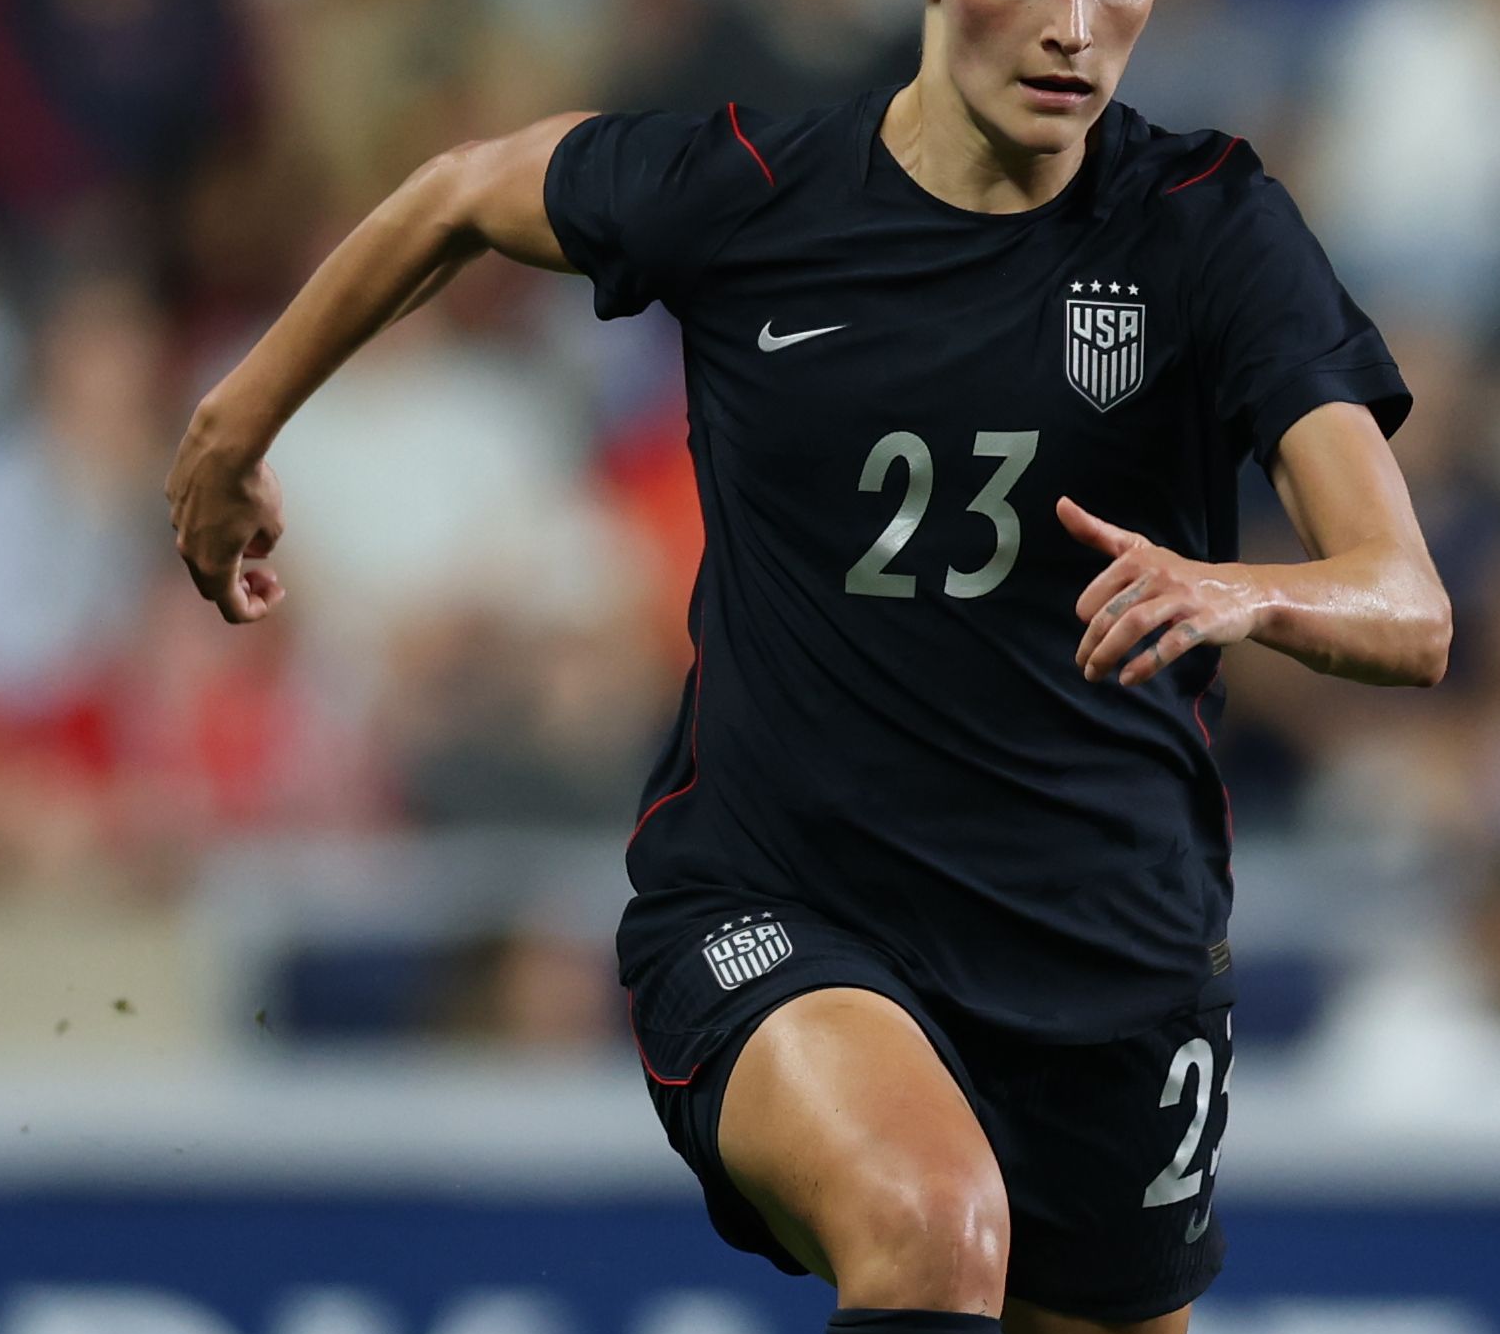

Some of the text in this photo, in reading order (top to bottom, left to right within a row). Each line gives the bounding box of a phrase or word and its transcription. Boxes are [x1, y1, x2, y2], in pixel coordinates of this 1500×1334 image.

[1073, 307, 1138, 349] USA
[845, 430, 1040, 599] 23
[711, 924, 778, 962] USA
[1142, 1010, 1235, 1208] 2
